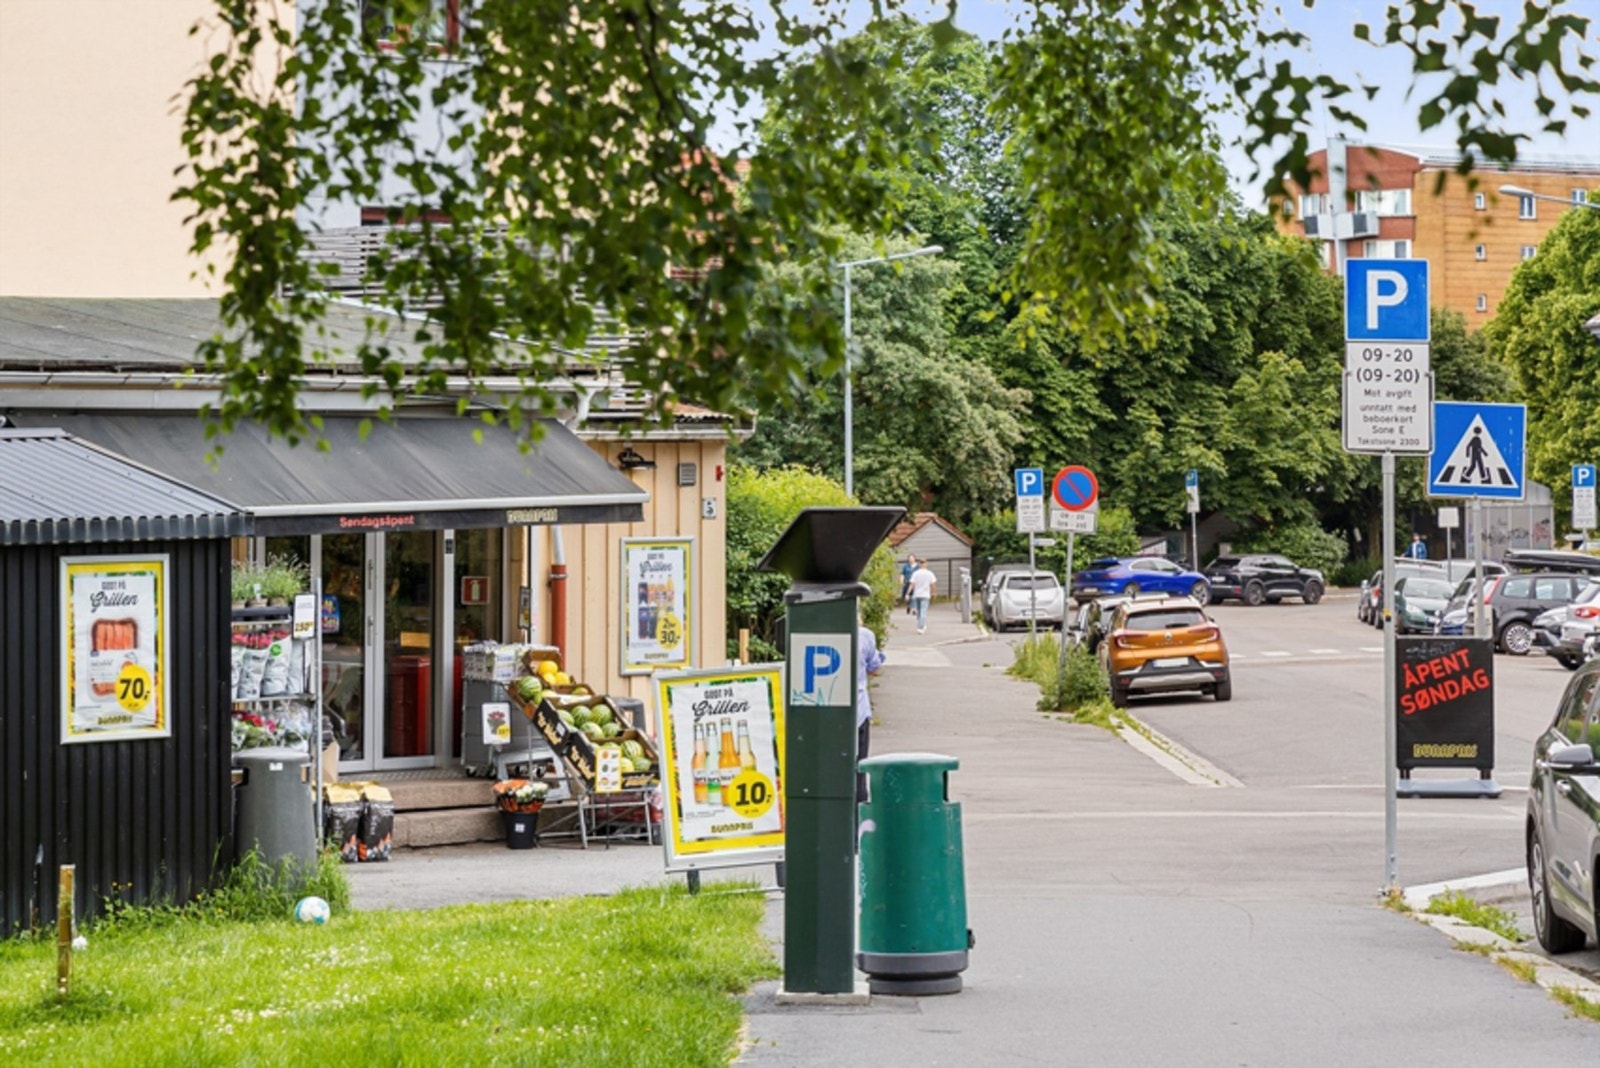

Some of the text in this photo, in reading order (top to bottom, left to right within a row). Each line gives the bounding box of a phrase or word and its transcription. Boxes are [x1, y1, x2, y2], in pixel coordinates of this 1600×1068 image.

[1366, 269, 1409, 331] P
[1364, 388, 1381, 397] Mot
[1397, 404, 1417, 413] med
[1372, 425, 1395, 434] Sone
[1022, 472, 1037, 493] P
[1578, 468, 1590, 485] P
[90, 591, 139, 613] Grillen
[804, 645, 841, 694] P
[1402, 648, 1470, 689] ÅPENT
[1400, 668, 1490, 715] SØNDAG
[692, 700, 751, 722] Grillen
